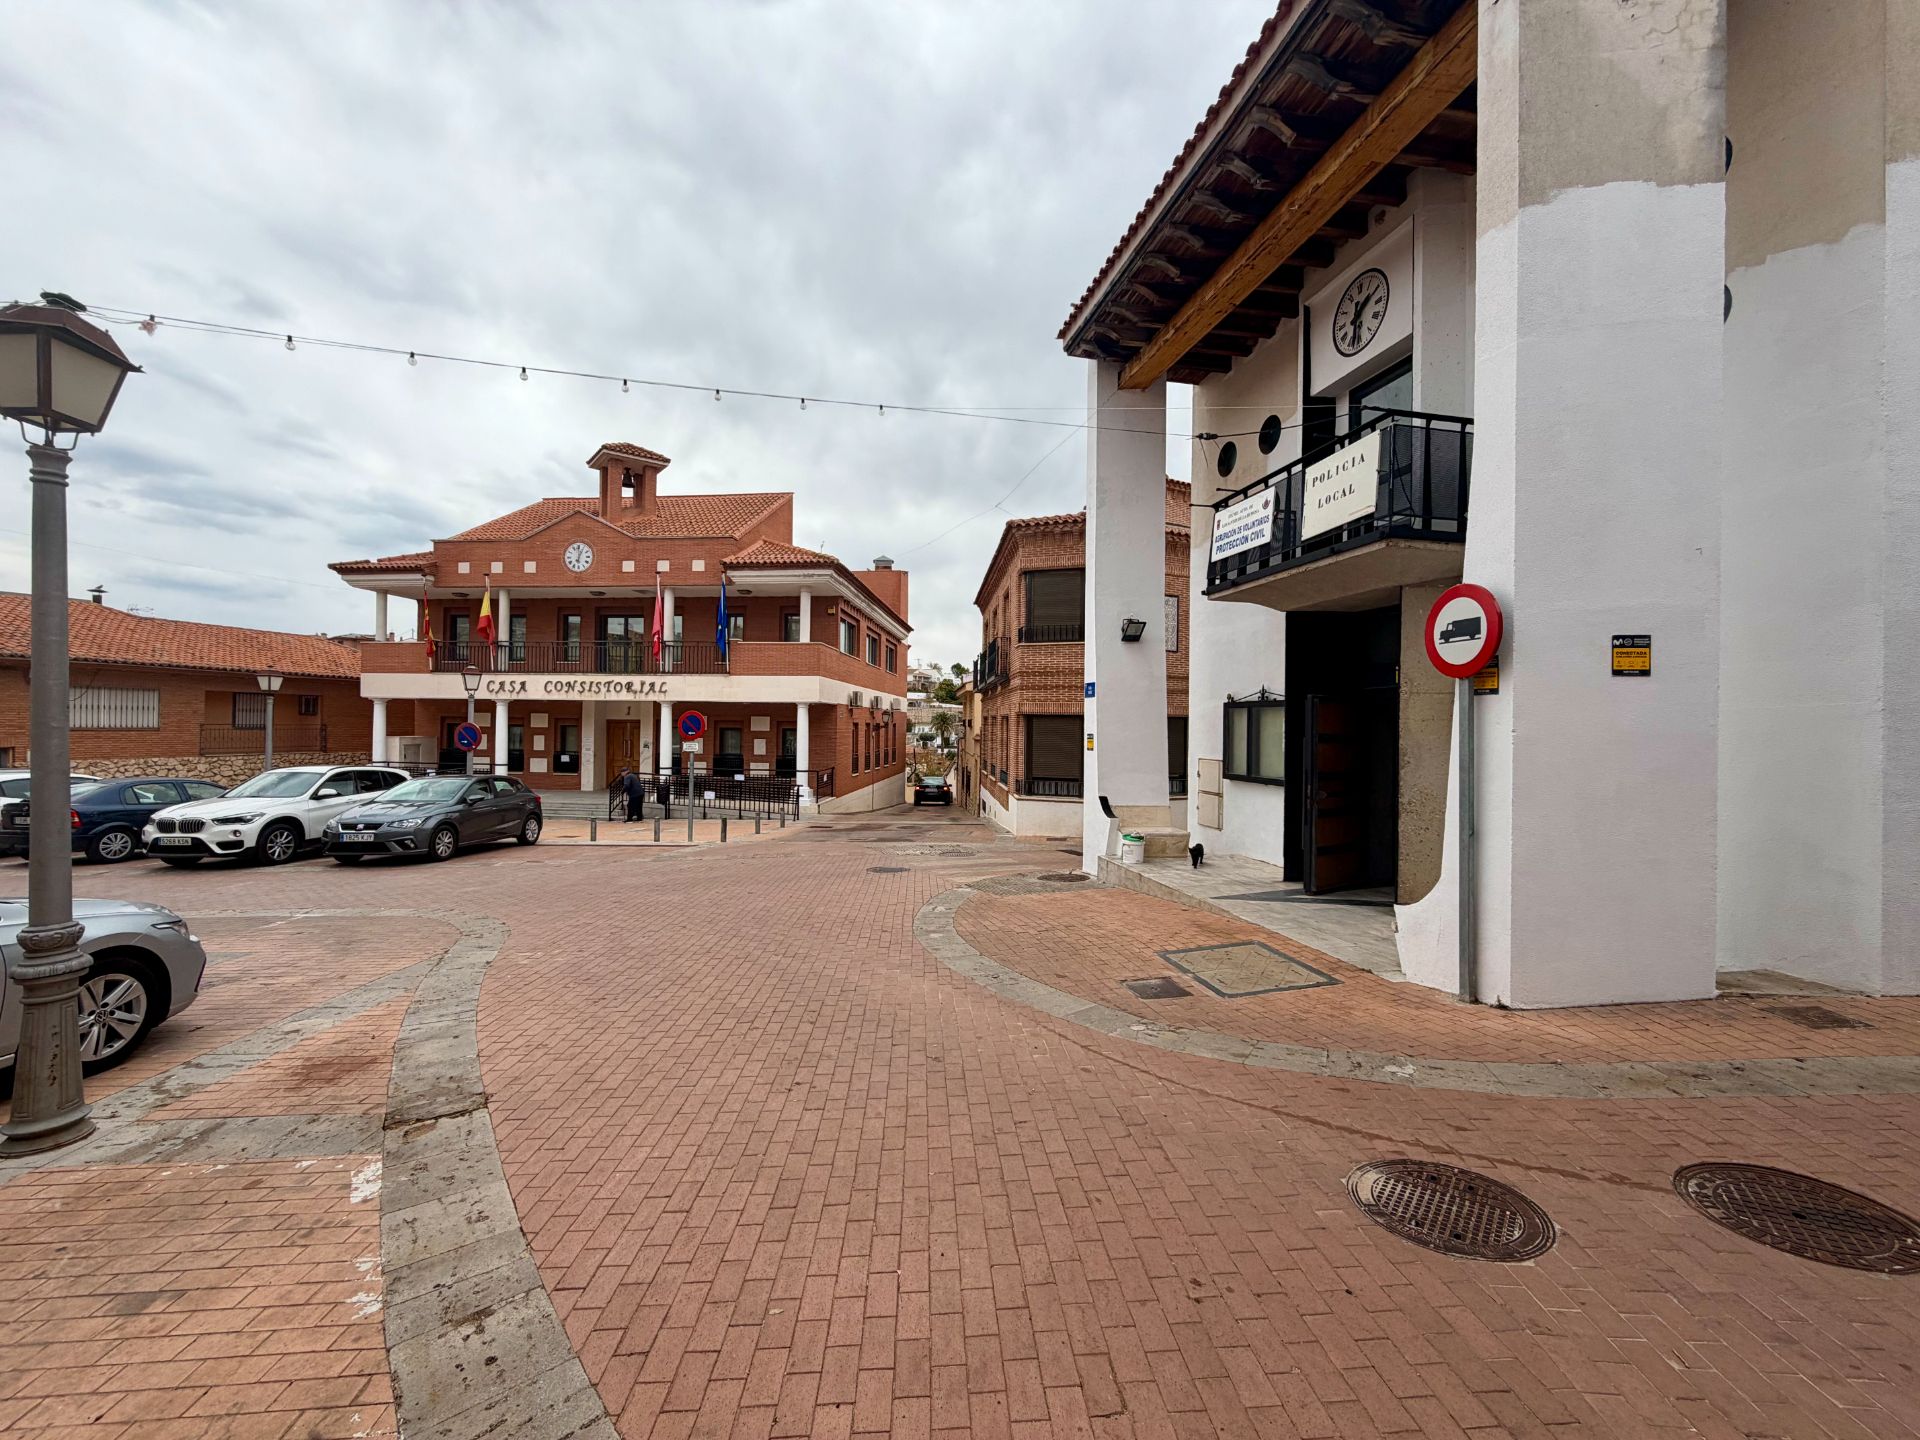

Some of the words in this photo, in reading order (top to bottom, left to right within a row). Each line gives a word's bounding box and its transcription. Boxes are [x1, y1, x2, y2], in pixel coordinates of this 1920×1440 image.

[1312, 453, 1365, 488] POLICIA
[1318, 483, 1355, 509] LOCAL
[1250, 528, 1266, 542] CIVIL
[486, 680, 527, 694] CASA
[544, 680, 668, 695] CONSISTORIAL
